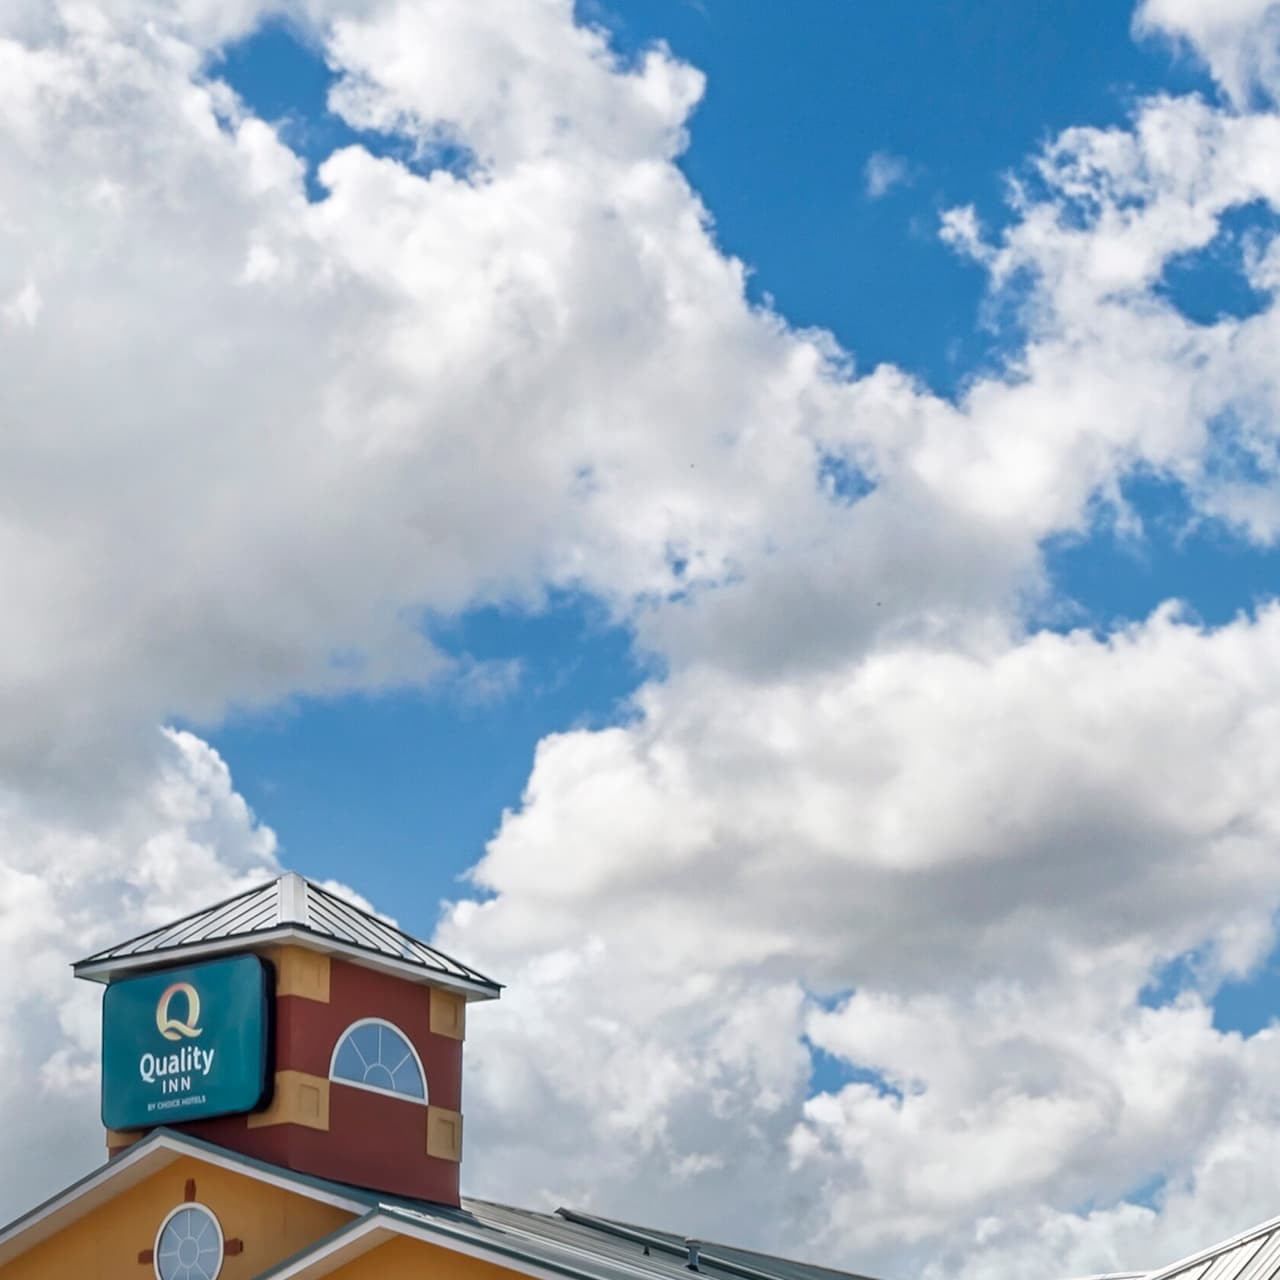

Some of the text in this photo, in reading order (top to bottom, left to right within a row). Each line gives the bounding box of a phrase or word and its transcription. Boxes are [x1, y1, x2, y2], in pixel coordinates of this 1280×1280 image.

[156, 982, 204, 1041] Q
[139, 1045, 215, 1084] Quality
[162, 1075, 191, 1095] INN
[147, 1095, 206, 1112] BY CHOICE HOTELS
